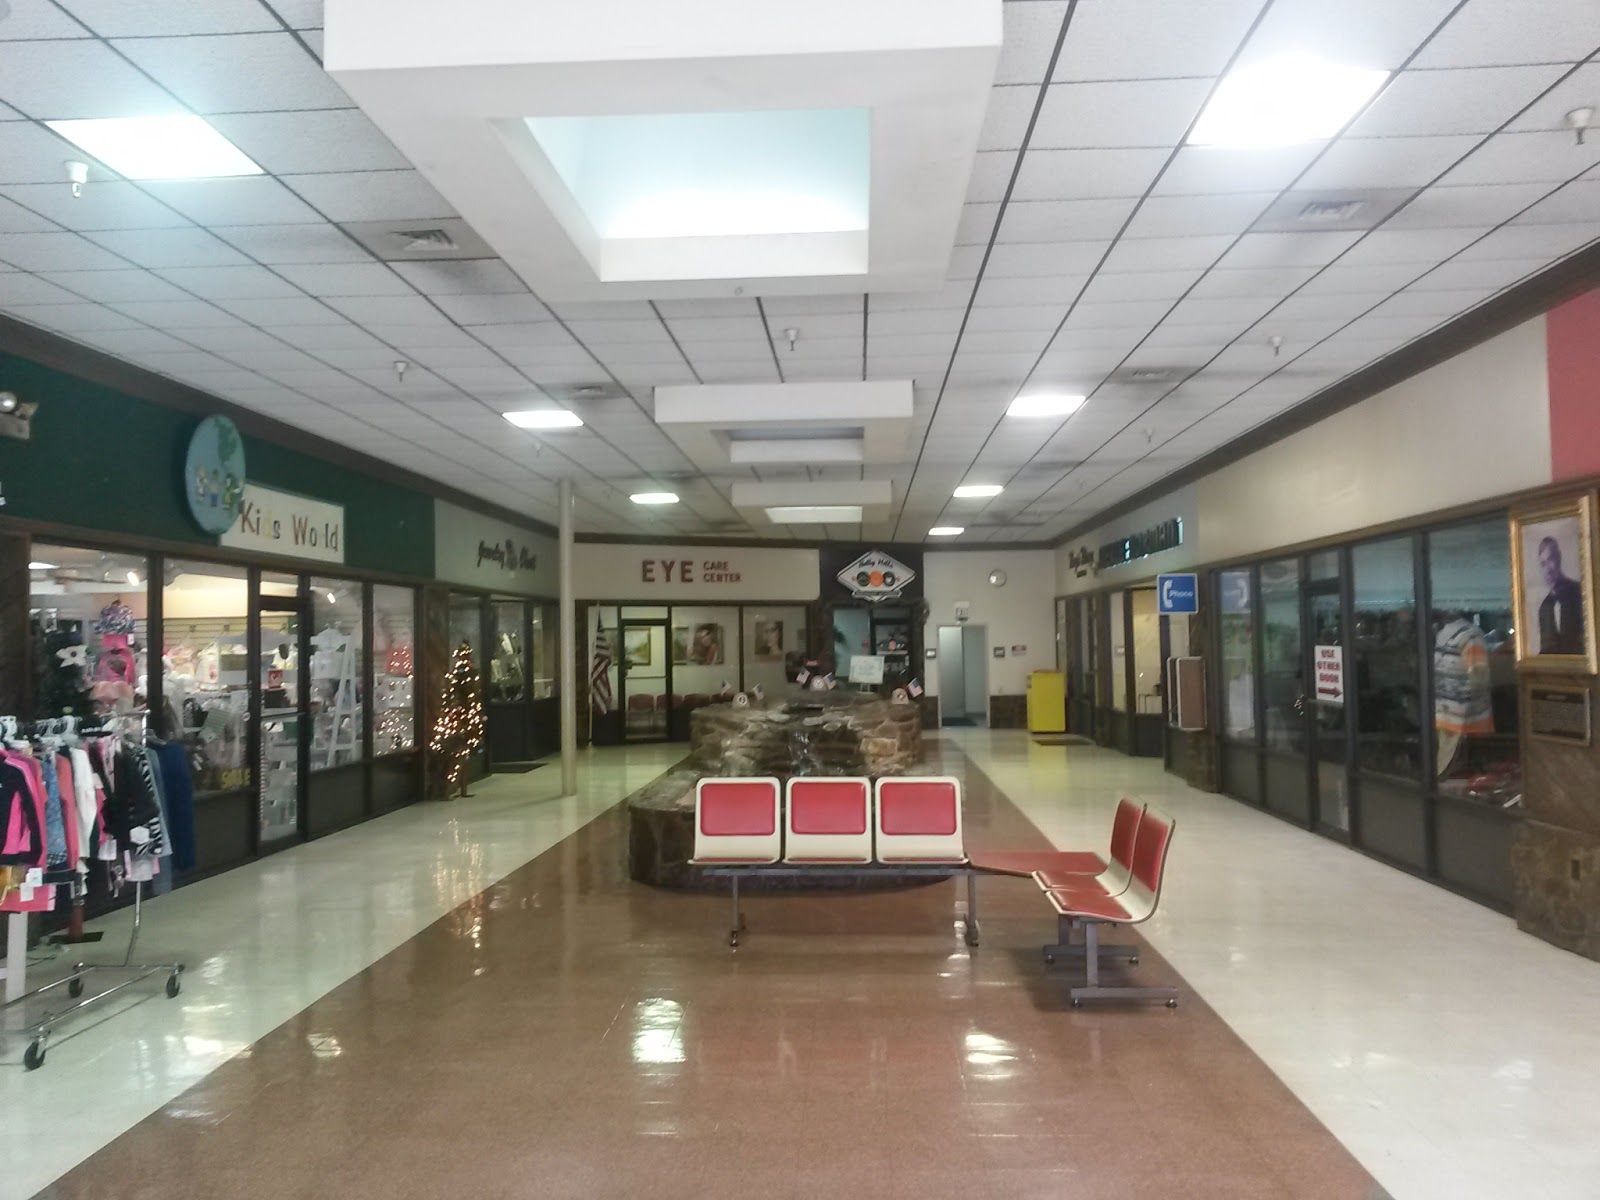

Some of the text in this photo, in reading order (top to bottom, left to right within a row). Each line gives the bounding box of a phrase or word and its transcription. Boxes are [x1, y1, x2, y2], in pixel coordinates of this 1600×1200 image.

[239, 500, 339, 552] Kids Wold
[703, 561, 729, 571] CARE
[642, 560, 694, 583] EYE
[703, 573, 741, 583] CENTER
[1168, 589, 1194, 598] Phone
[1321, 649, 1335, 658] USE
[1317, 660, 1340, 670] OTHER
[1319, 672, 1339, 683] DOOR
